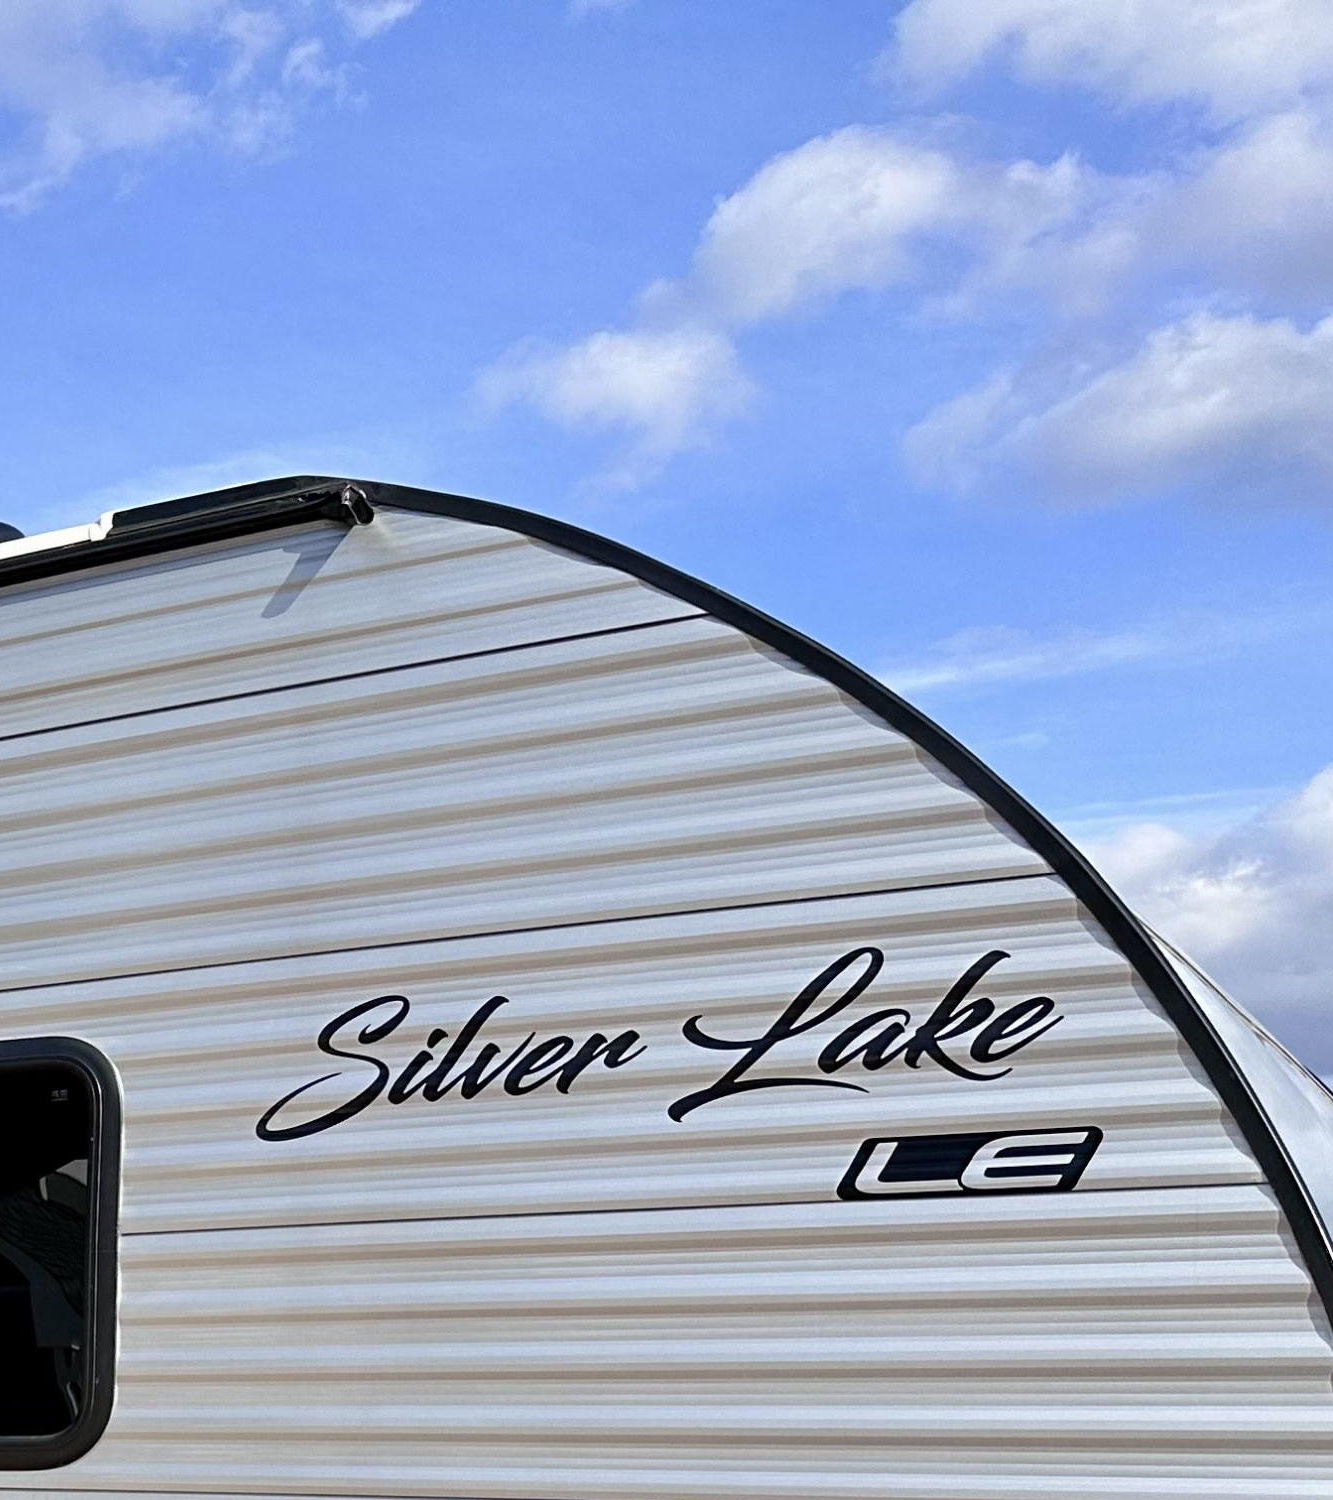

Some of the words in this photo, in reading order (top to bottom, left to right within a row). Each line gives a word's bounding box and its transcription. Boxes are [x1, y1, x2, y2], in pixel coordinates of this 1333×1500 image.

[255, 994, 648, 1142] Silver
[667, 946, 1066, 1124] Lake
[853, 1131, 1090, 1195] LE
